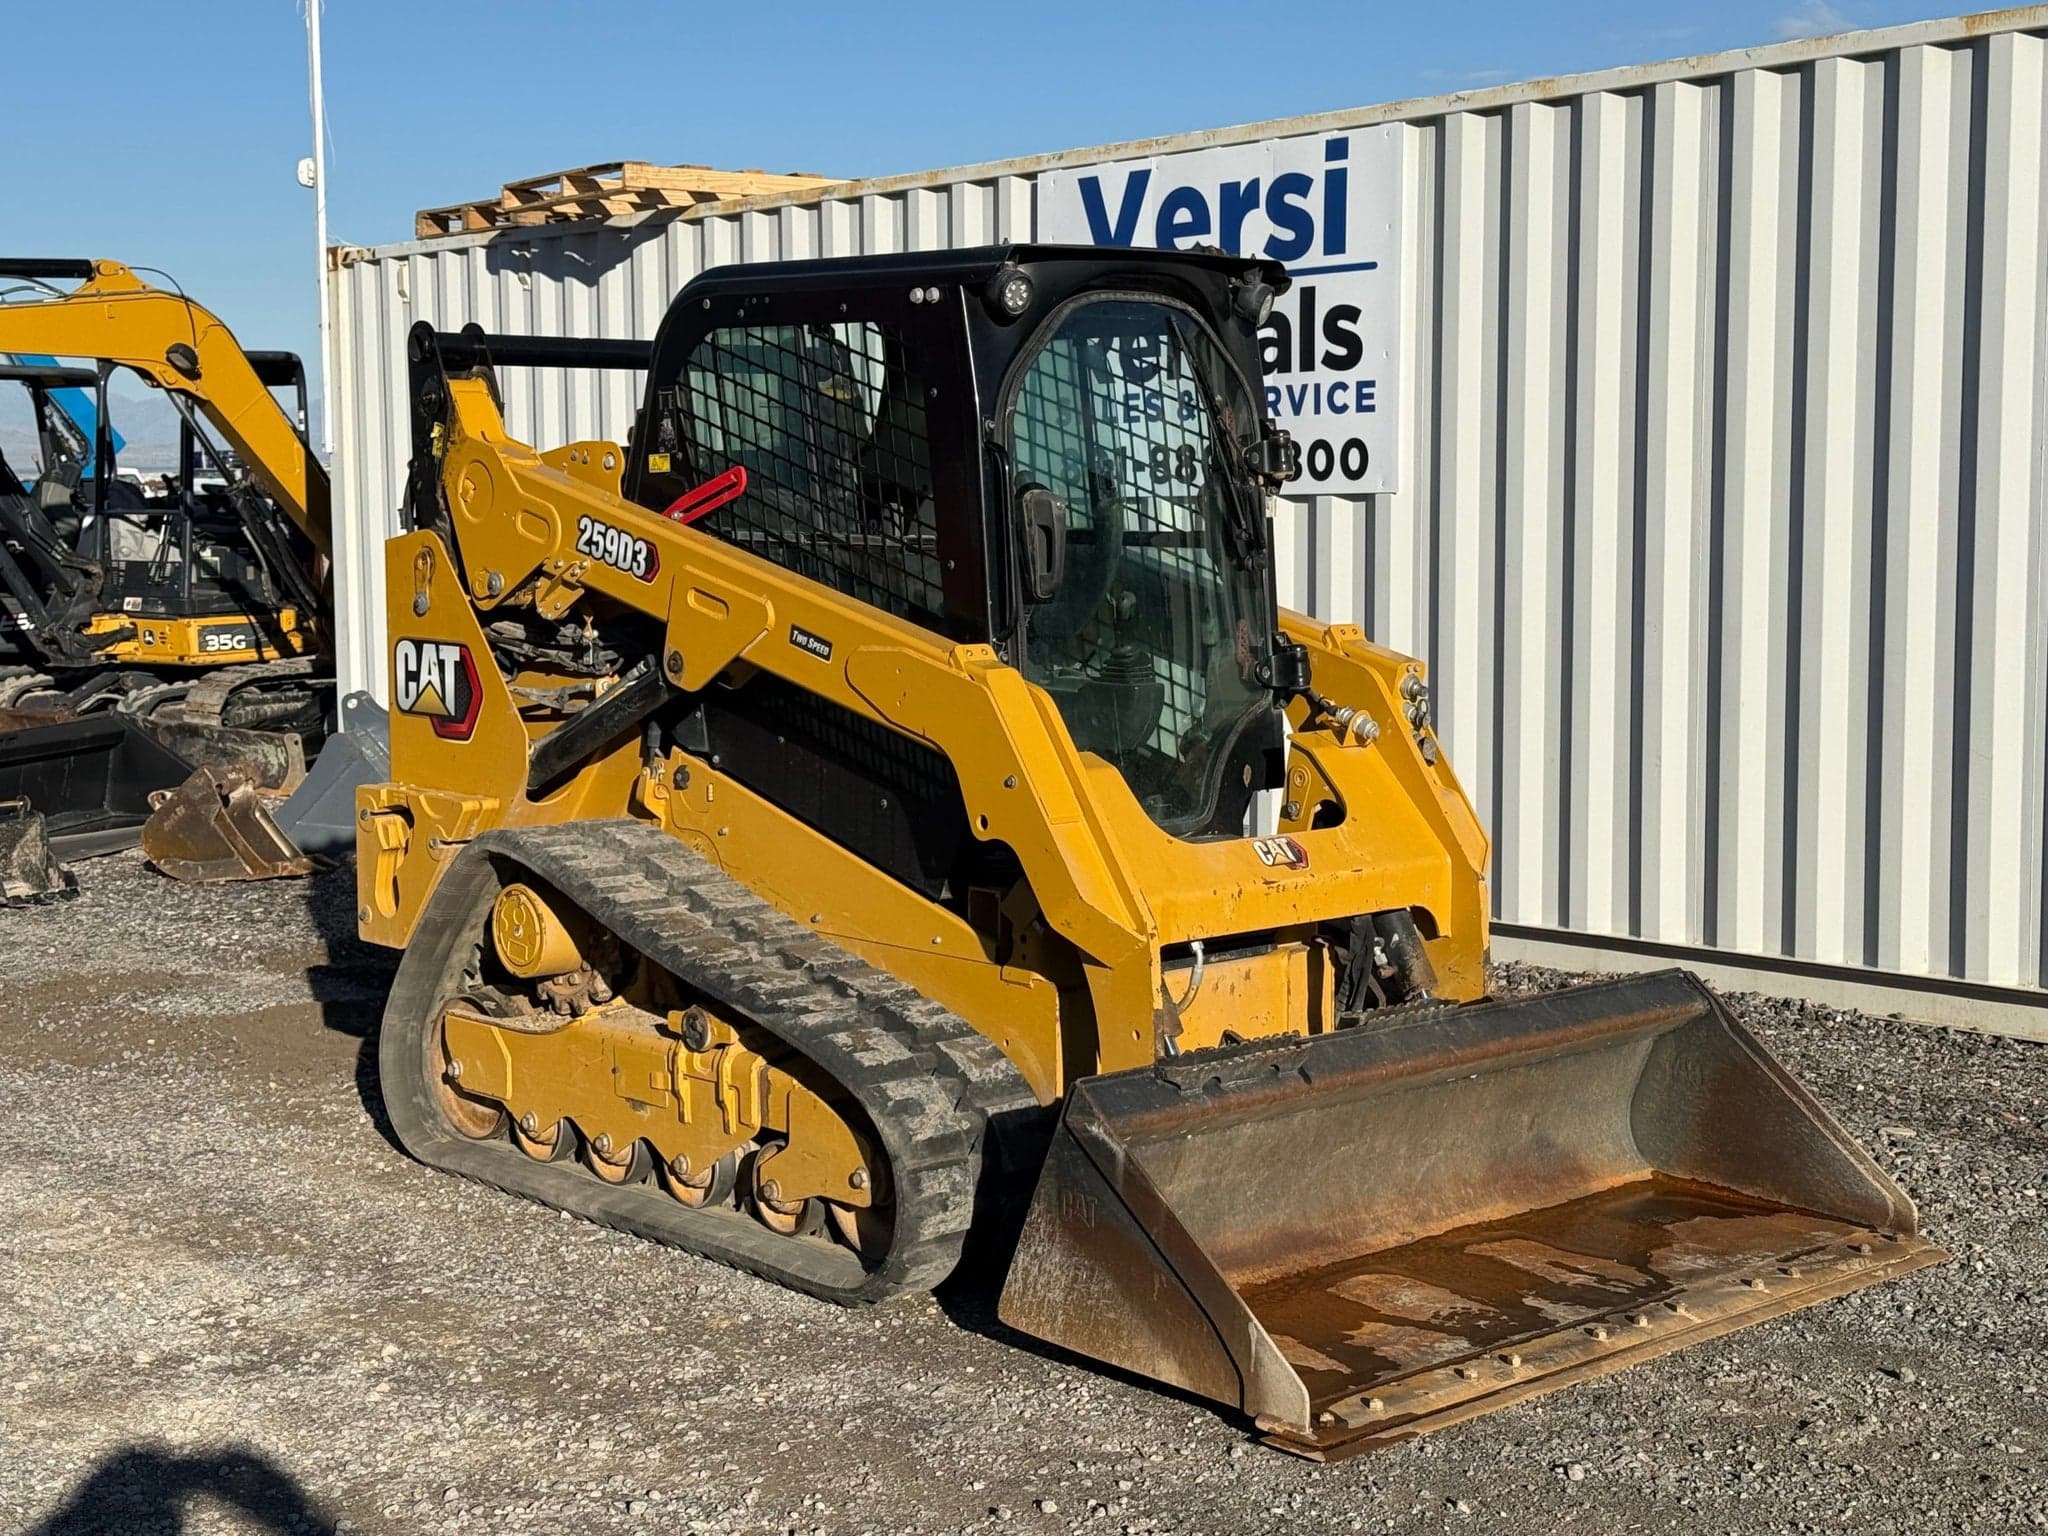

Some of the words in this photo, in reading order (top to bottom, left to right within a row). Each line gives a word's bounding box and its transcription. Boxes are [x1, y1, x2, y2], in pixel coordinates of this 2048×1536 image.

[1078, 136, 1349, 262] Versi
[1177, 389, 1196, 421] &
[1264, 379, 1376, 417] RVICE
[577, 515, 648, 578] 259D3
[205, 633, 246, 652] 35G
[396, 639, 460, 716] CAT
[1253, 837, 1297, 866] CAT
